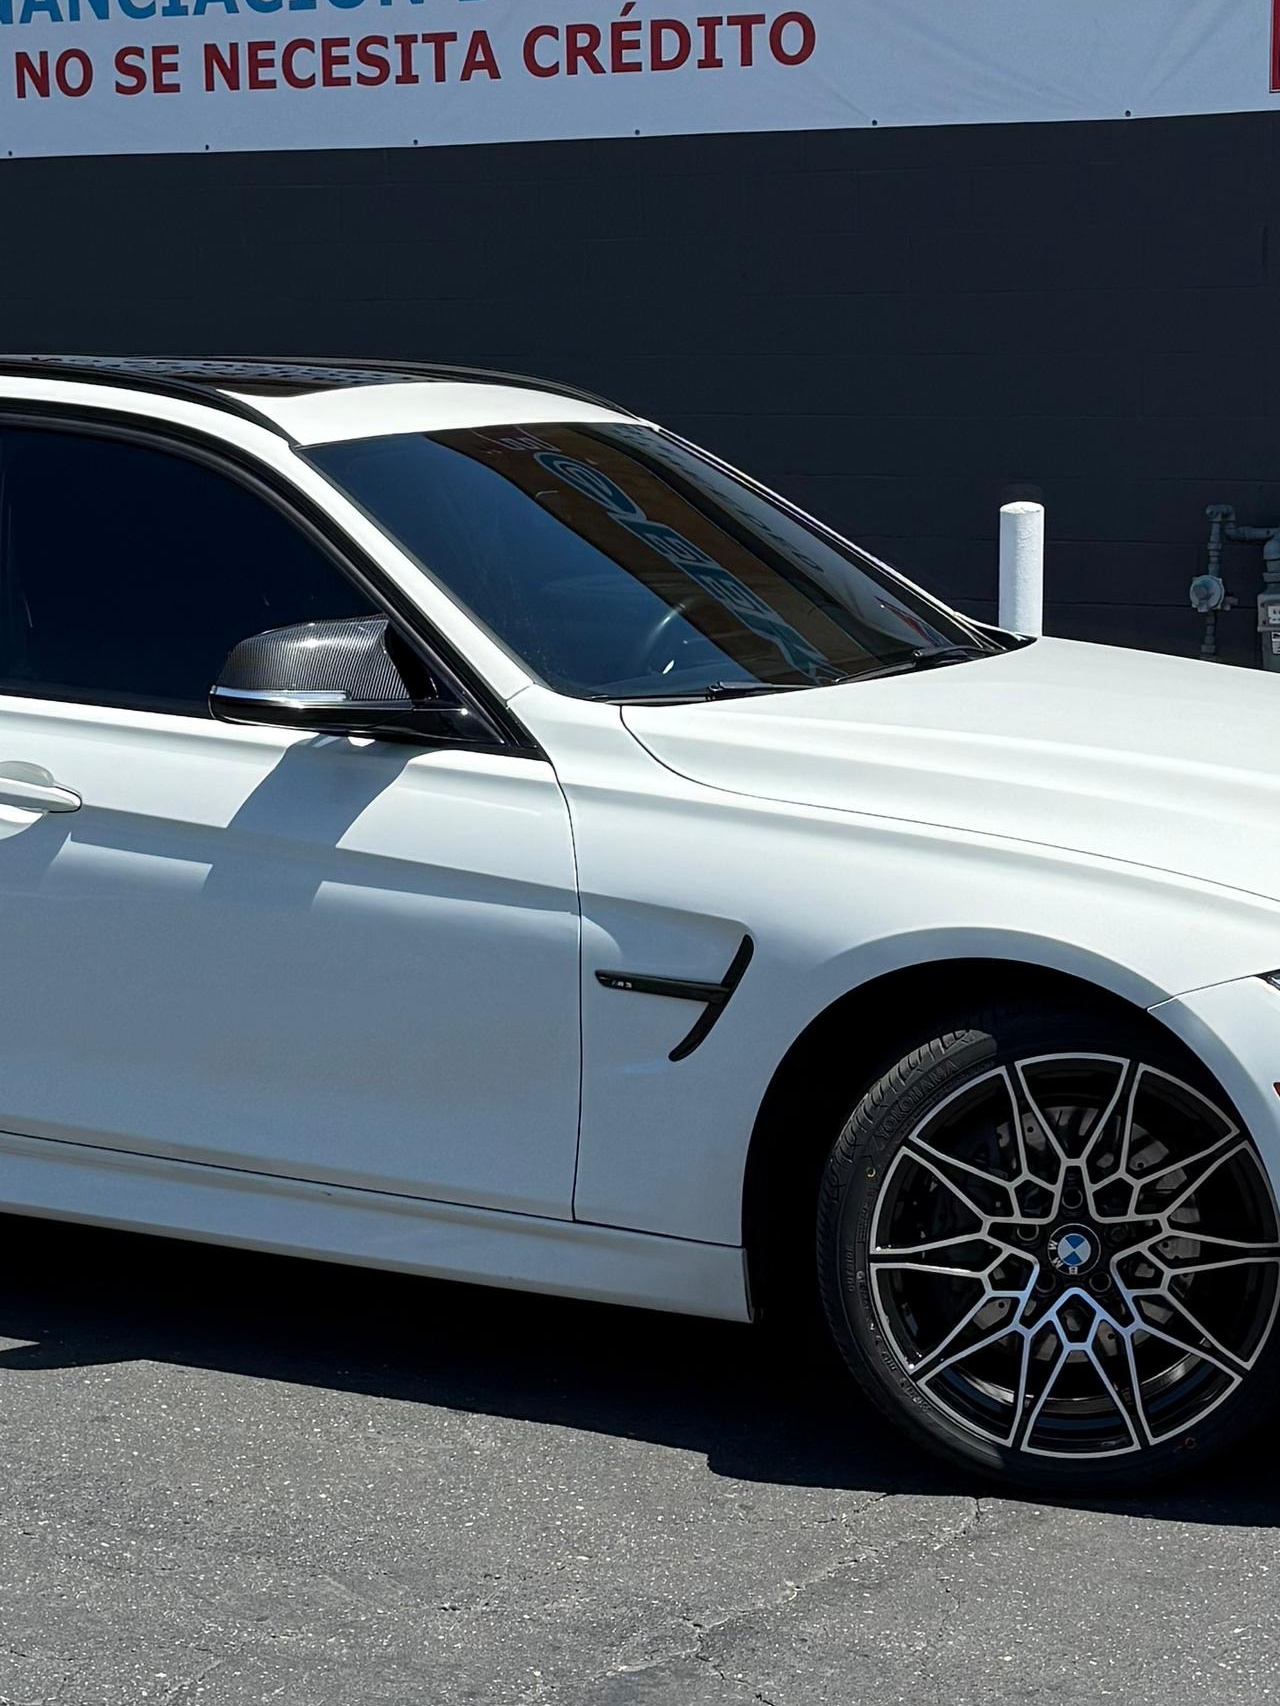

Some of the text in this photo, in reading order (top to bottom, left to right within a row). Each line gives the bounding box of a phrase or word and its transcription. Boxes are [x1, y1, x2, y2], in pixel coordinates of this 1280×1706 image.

[16, 2, 816, 99] NO SE NECESITA CRÉDITO
